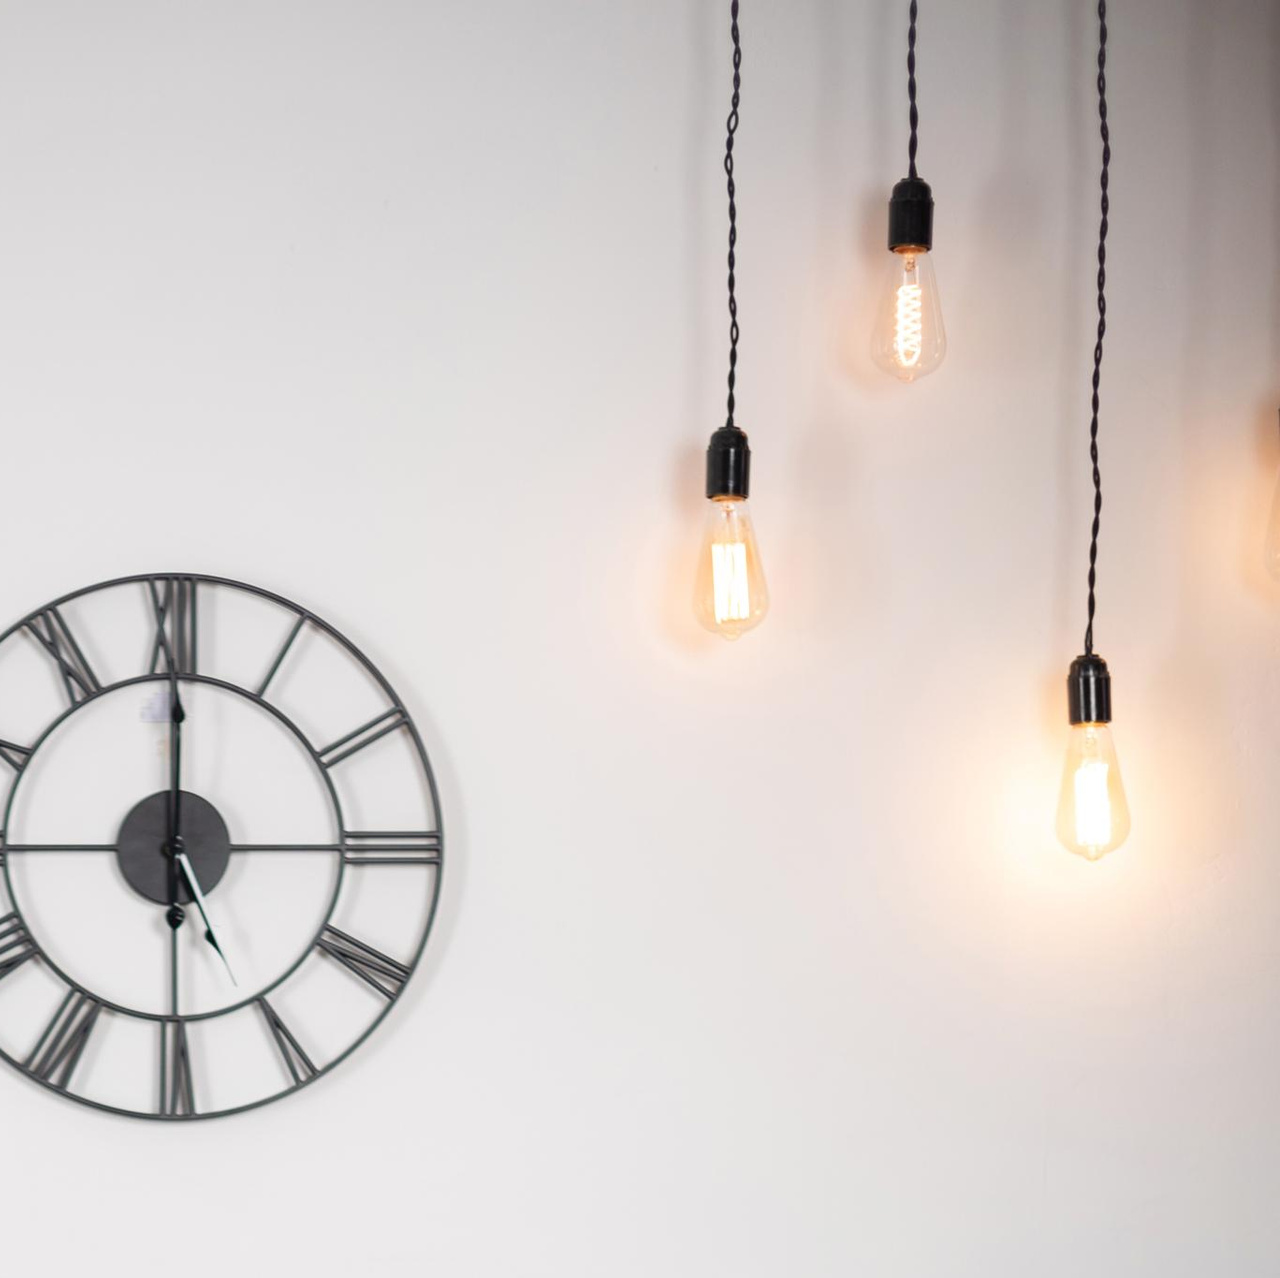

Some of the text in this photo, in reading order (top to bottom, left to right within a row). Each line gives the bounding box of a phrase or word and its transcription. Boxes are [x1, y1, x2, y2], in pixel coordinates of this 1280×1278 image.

[23, 604, 108, 705] XI
[317, 705, 411, 771] II
[341, 829, 442, 865] III
[316, 922, 413, 1002] IV
[23, 985, 107, 1092] VII
[156, 1018, 197, 1118] VI
[256, 995, 321, 1088] V
